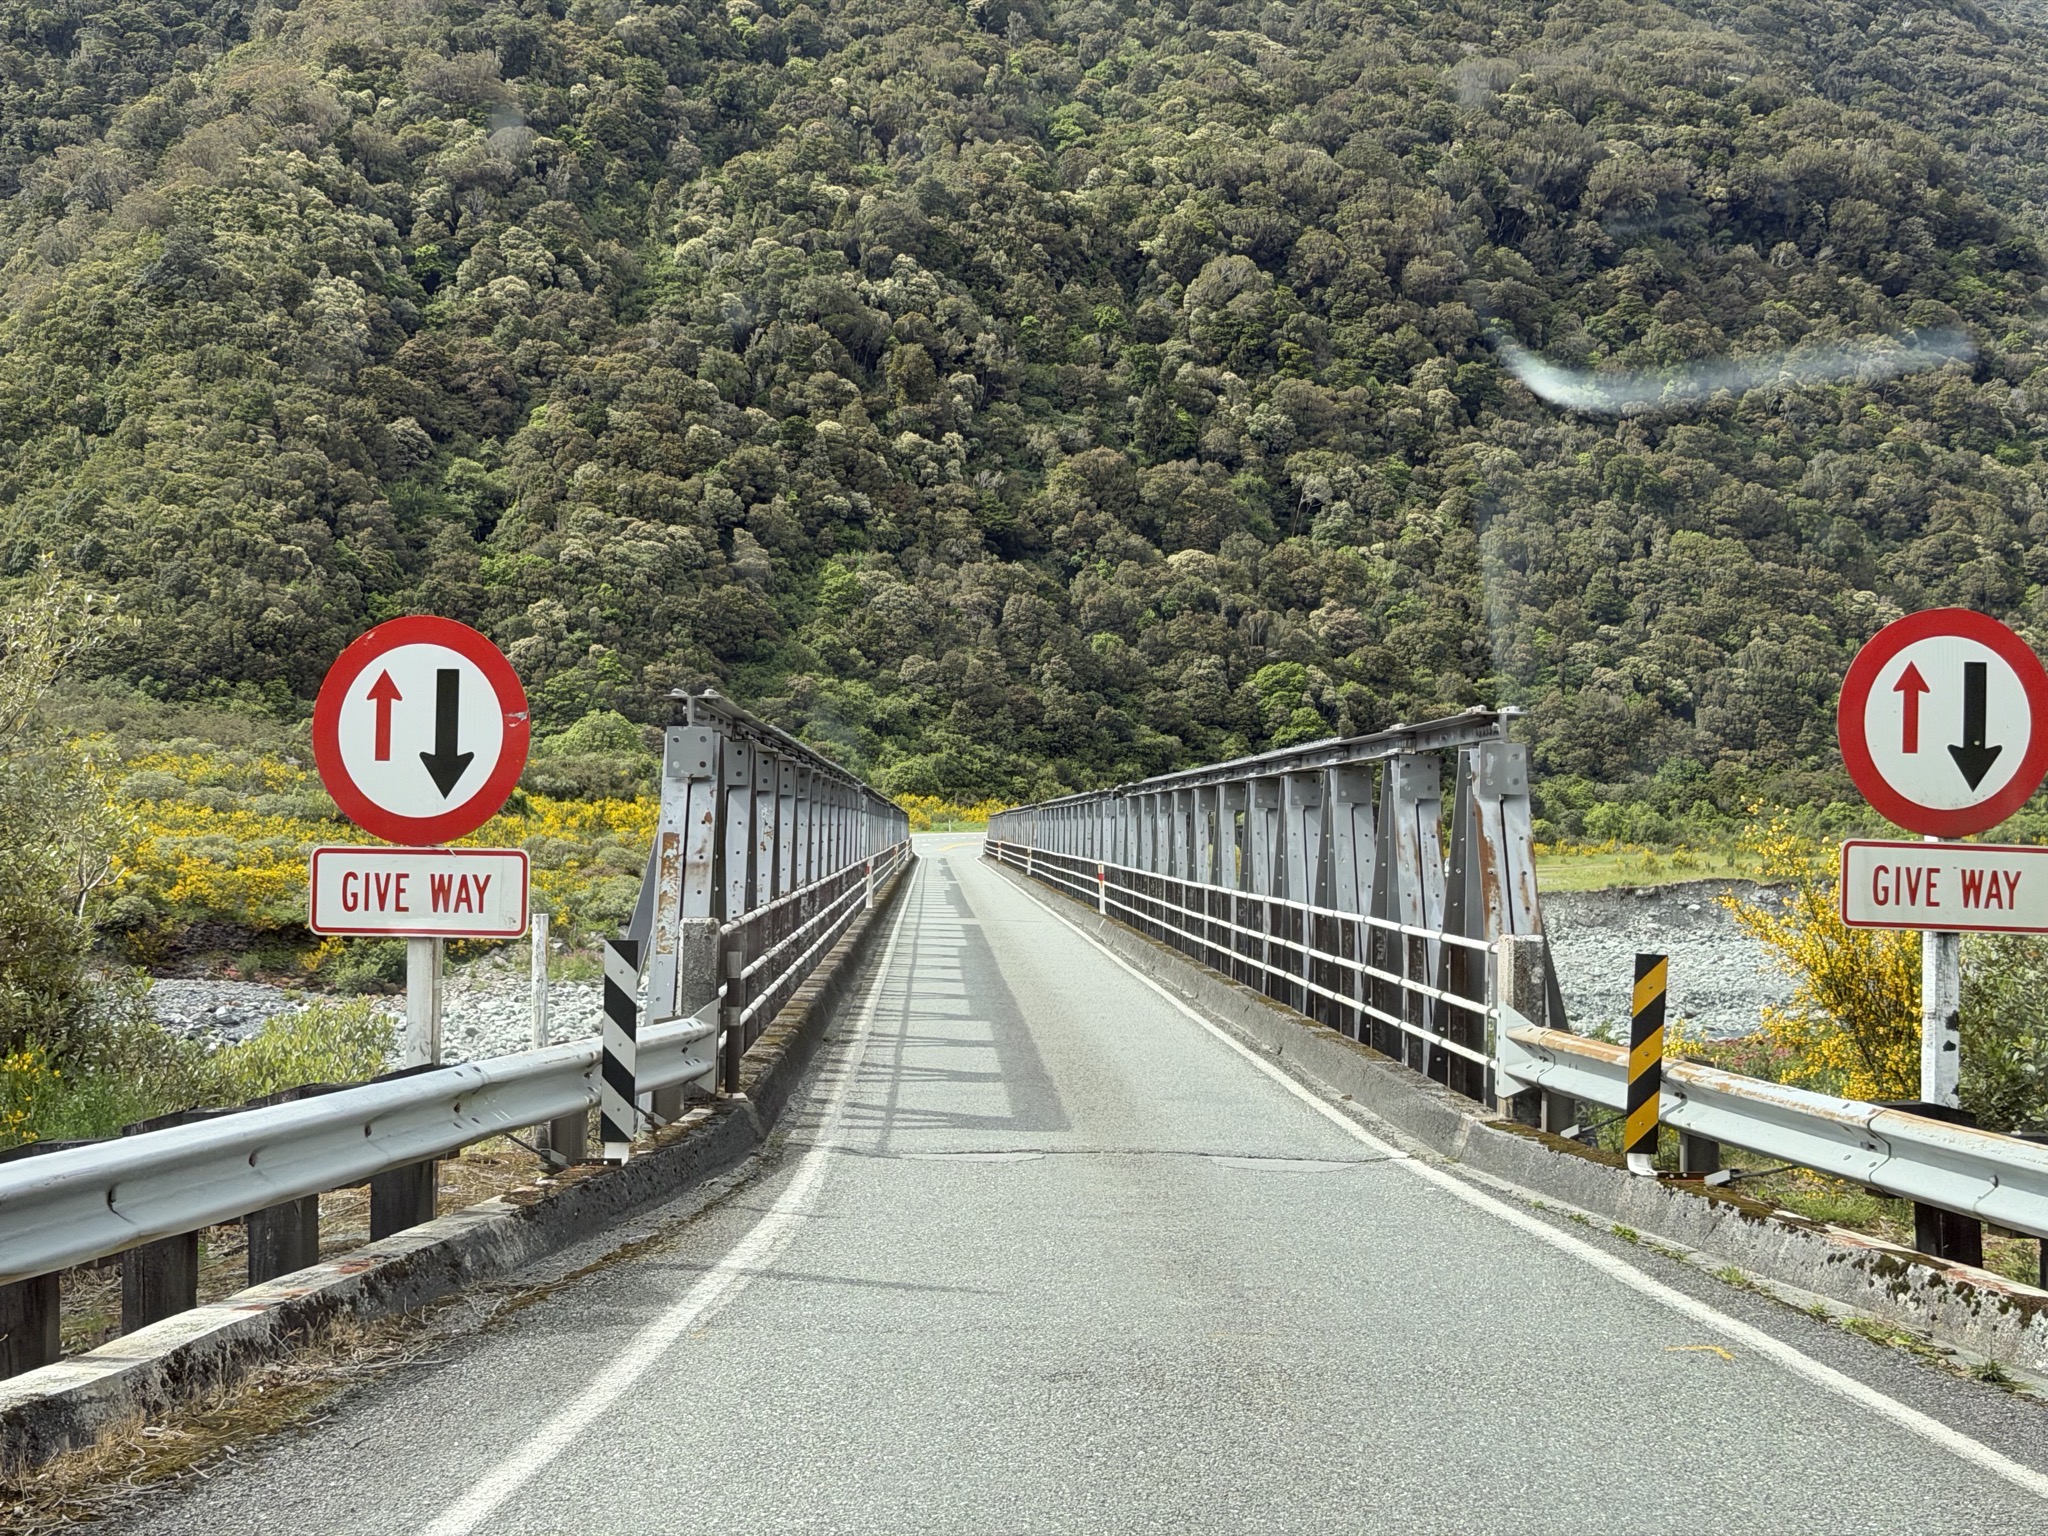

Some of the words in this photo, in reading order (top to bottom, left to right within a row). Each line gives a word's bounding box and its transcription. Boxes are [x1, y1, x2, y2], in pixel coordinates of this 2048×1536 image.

[342, 871, 410, 912] GIVE
[430, 873, 492, 914] WAY
[1872, 864, 1941, 907] GIVE
[1960, 868, 2022, 910] WAY
